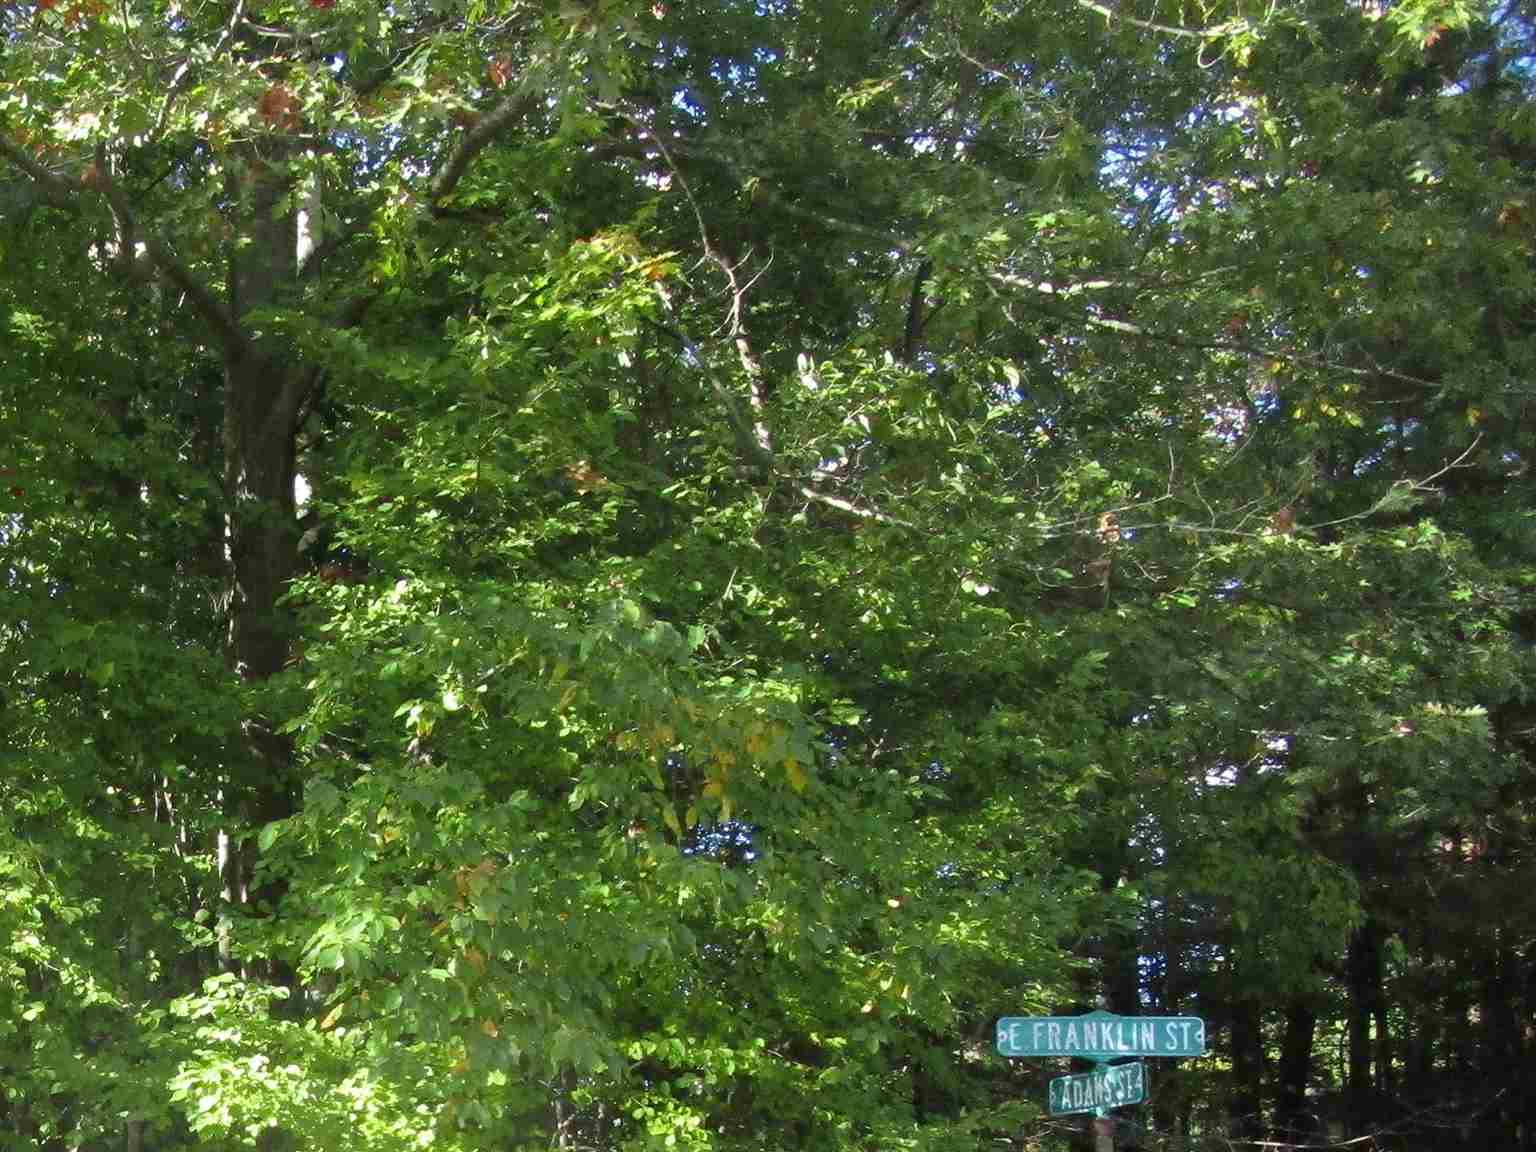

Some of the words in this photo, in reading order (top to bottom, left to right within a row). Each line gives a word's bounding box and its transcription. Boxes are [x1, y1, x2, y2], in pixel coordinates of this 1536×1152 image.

[1009, 1023, 1021, 1050] E
[1033, 1022, 1155, 1050] FRANKLIN
[1165, 1022, 1192, 1050] ST
[1061, 1074, 1112, 1109] ADAMS
